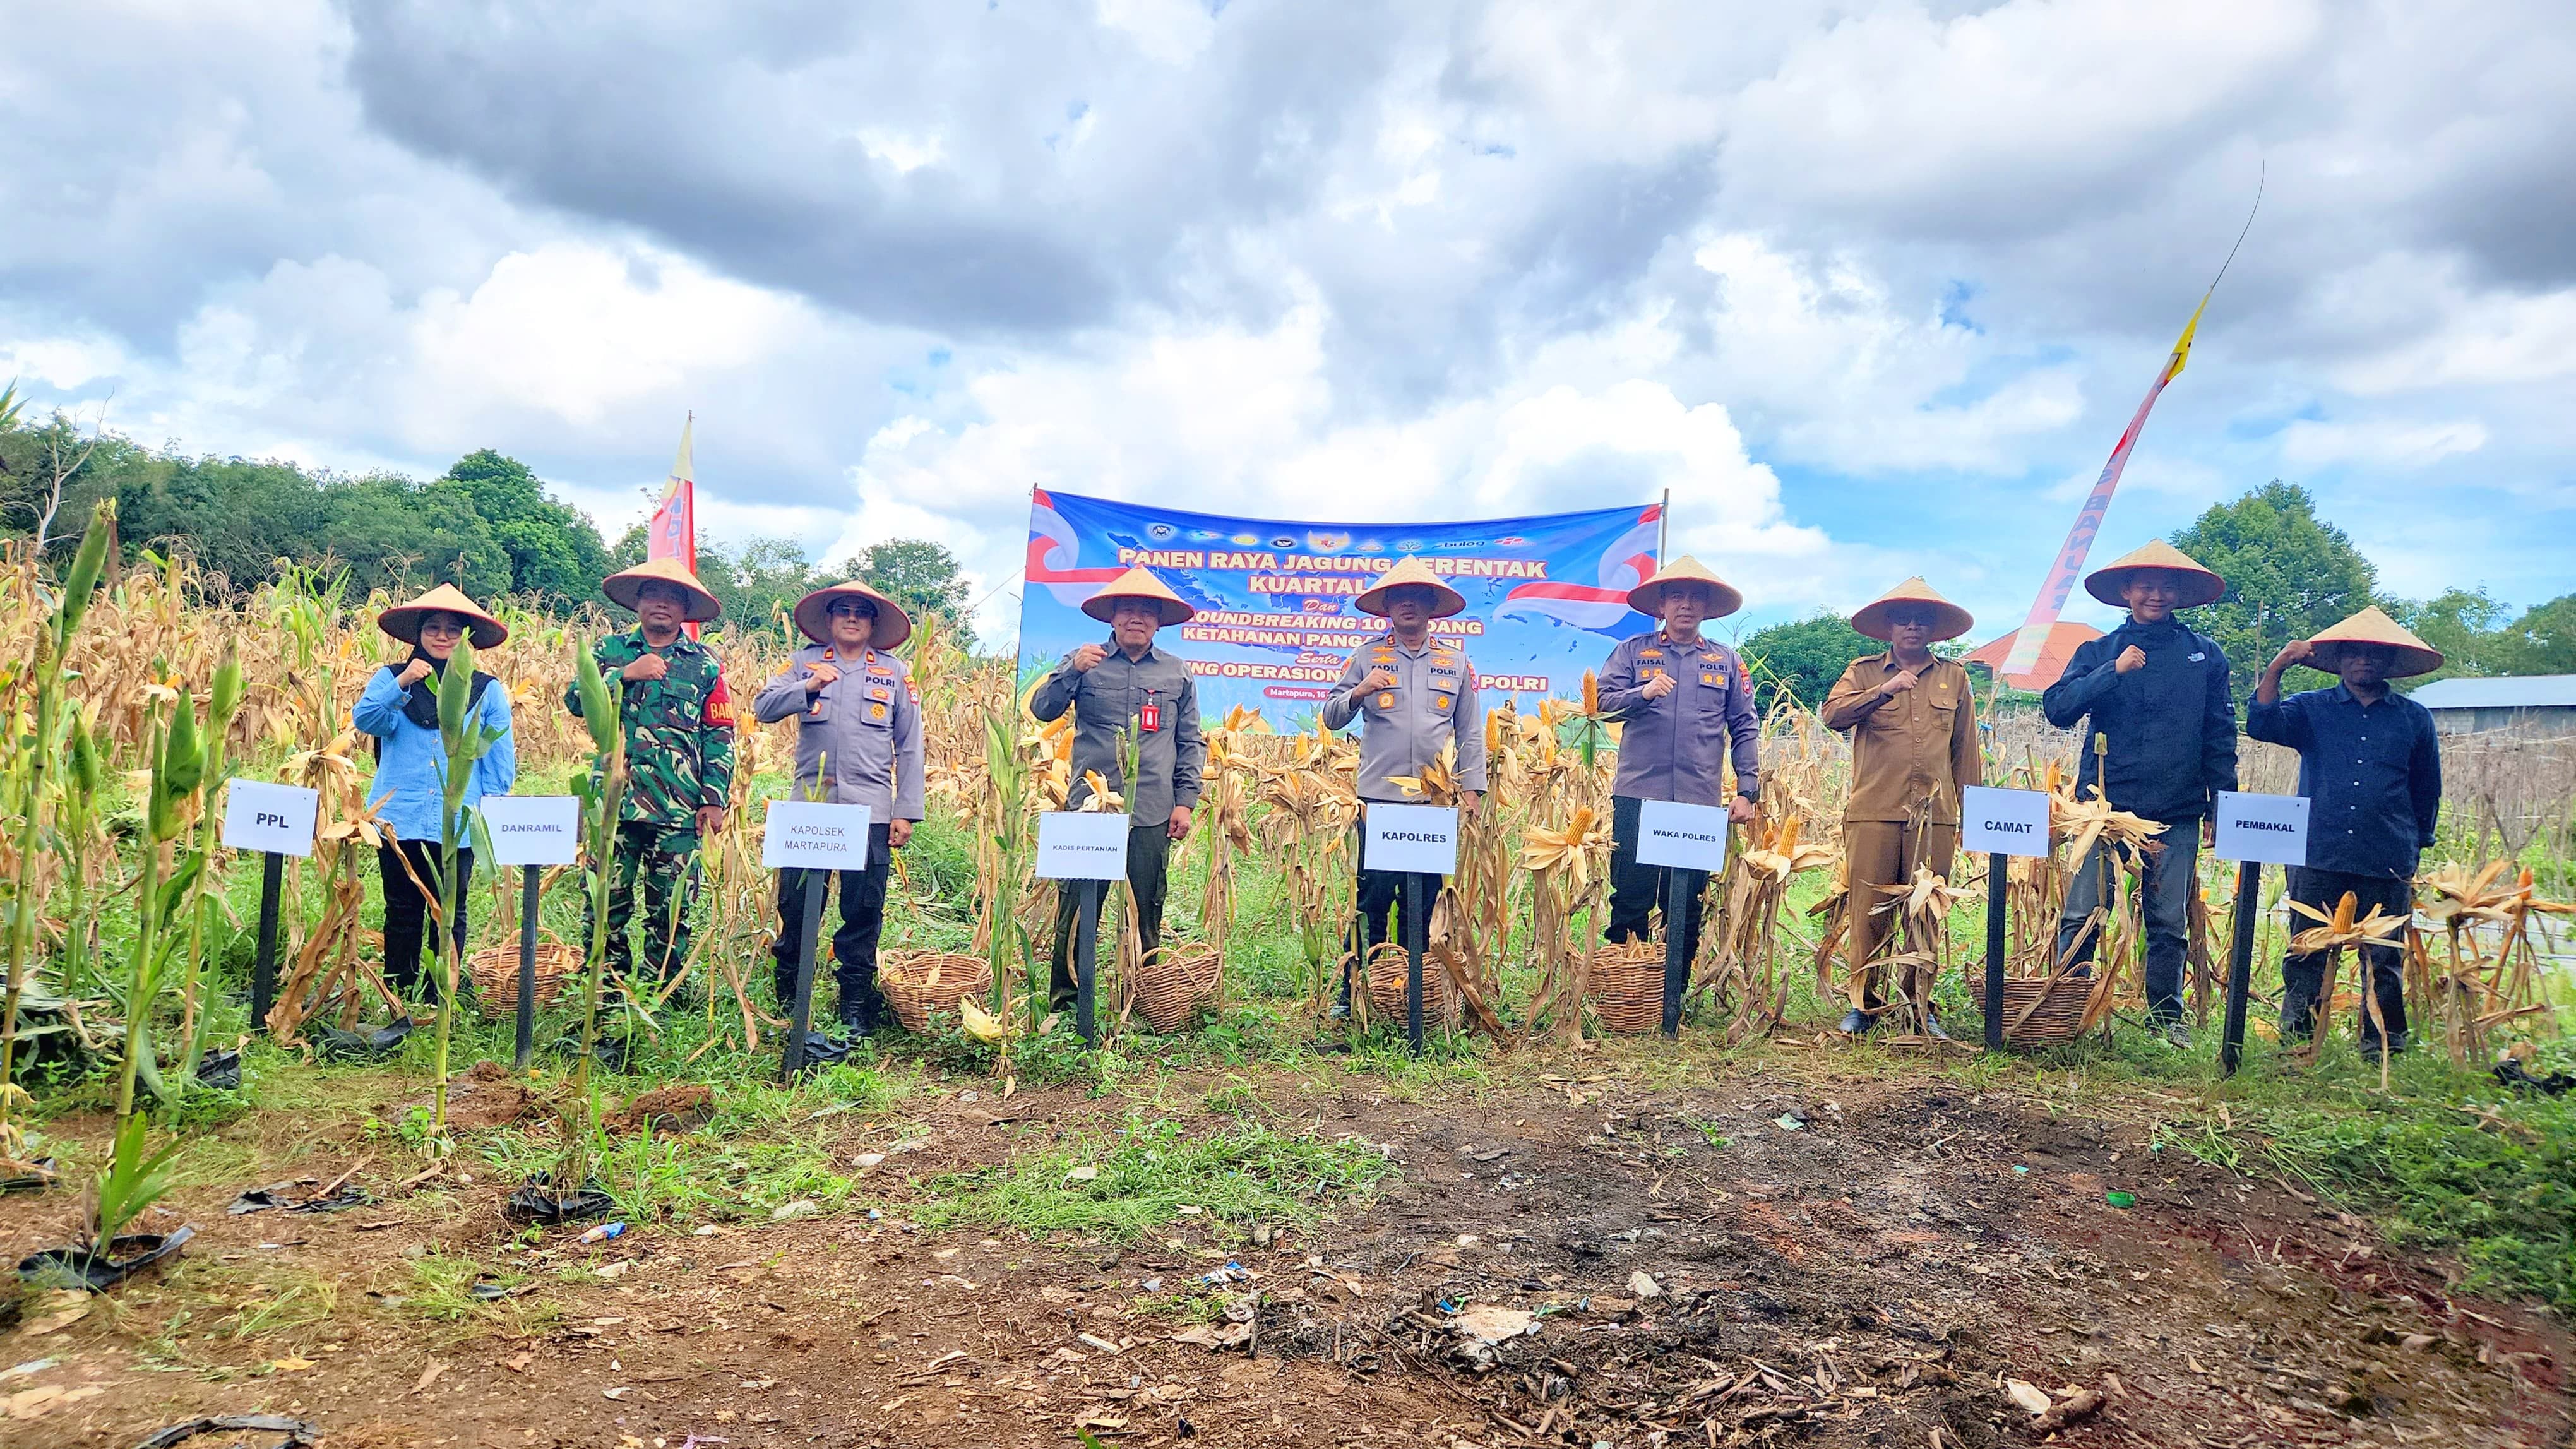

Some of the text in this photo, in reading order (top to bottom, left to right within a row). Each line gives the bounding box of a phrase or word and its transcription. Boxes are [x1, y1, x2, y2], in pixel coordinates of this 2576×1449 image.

[1119, 548, 1547, 578] PANEN RAYA JAGUNG ERENTAK
[1249, 576, 1368, 594] KUARTAL
[1304, 599, 1337, 611] Dan
[1190, 611, 1357, 630] OUNDBREAKING
[1428, 620, 1482, 635] DANG
[1183, 627, 1374, 647] KETAHANAN PANG
[1297, 651, 1340, 664] Serta
[1430, 667, 1457, 676] POLRI
[1700, 663, 1728, 672] POLRI
[865, 676, 895, 687] POLRI
[1222, 664, 1341, 682] OPERASION
[1481, 676, 1547, 691] POLRI
[1270, 689, 1315, 698] Martapura,
[256, 813, 289, 828] PPL
[1984, 820, 2033, 834] CAMAT
[2236, 819, 2295, 832] PEMBAKAL
[501, 824, 563, 832] DANRAMIL
[790, 825, 844, 837] KAPOLSEK
[1381, 831, 1447, 843] KAPOLRES
[1653, 829, 1717, 842] WAKA POLRES
[785, 840, 847, 852] MARTAPURA
